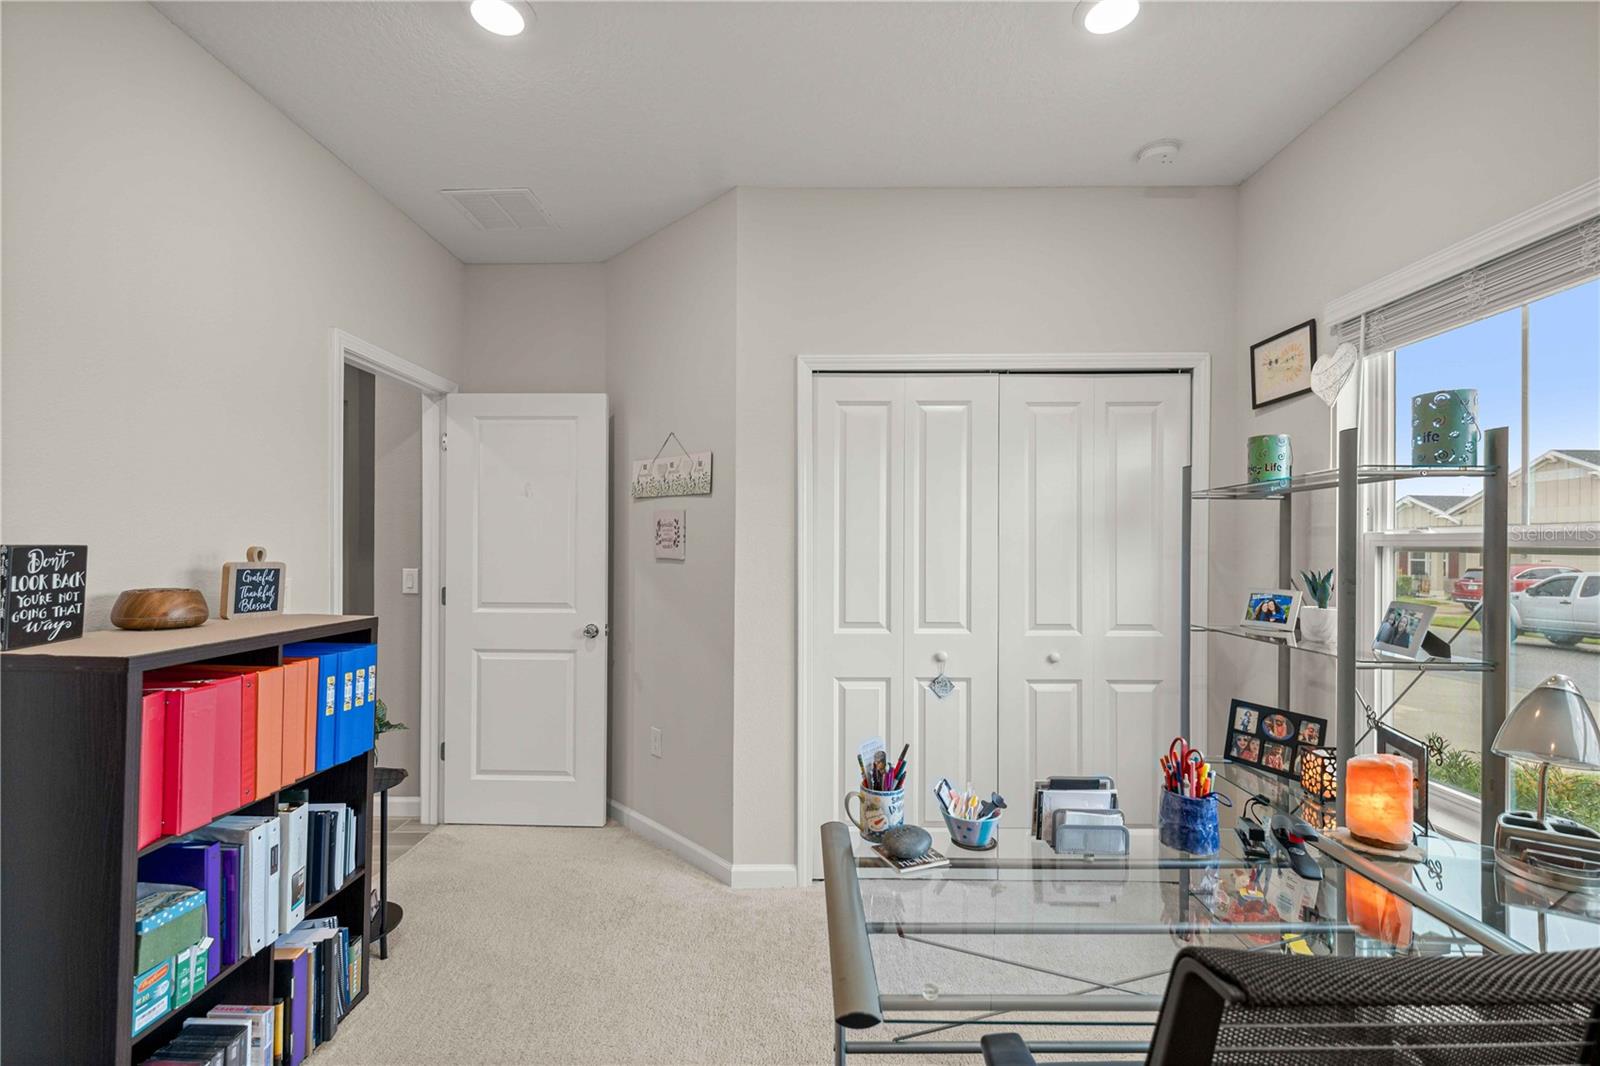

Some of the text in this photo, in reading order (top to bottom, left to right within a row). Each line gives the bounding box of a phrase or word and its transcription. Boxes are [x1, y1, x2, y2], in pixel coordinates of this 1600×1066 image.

[1264, 463, 1282, 472] Life
[27, 548, 75, 574] Don't
[11, 571, 86, 592] LOOK BACK
[242, 569, 275, 585] Grateful
[16, 591, 80, 608] YOU'RE NOT
[240, 585, 276, 601] Thankful
[11, 603, 83, 623] GOING THAT
[238, 598, 273, 612] Blessed
